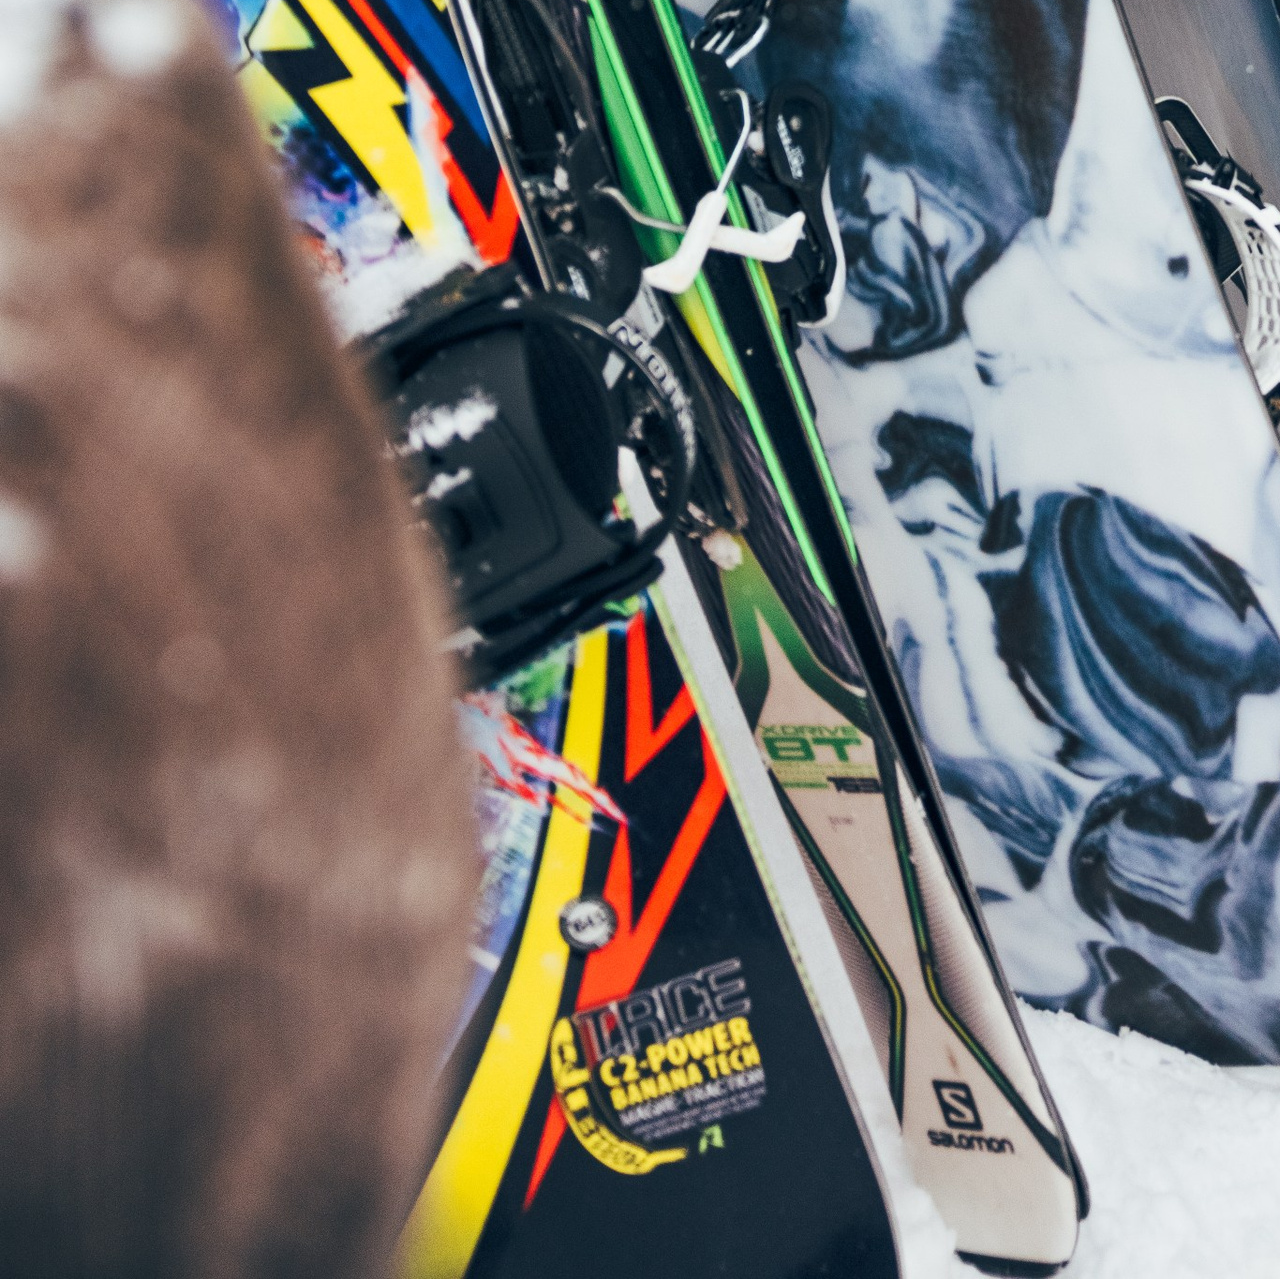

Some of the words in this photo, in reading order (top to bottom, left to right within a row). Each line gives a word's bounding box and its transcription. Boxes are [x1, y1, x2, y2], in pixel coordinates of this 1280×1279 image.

[599, 1016, 753, 1088] C2-POWER
[609, 1061, 704, 1111] BANANA
[703, 1042, 762, 1079] TECH
[928, 1130, 1015, 1154] salomon
